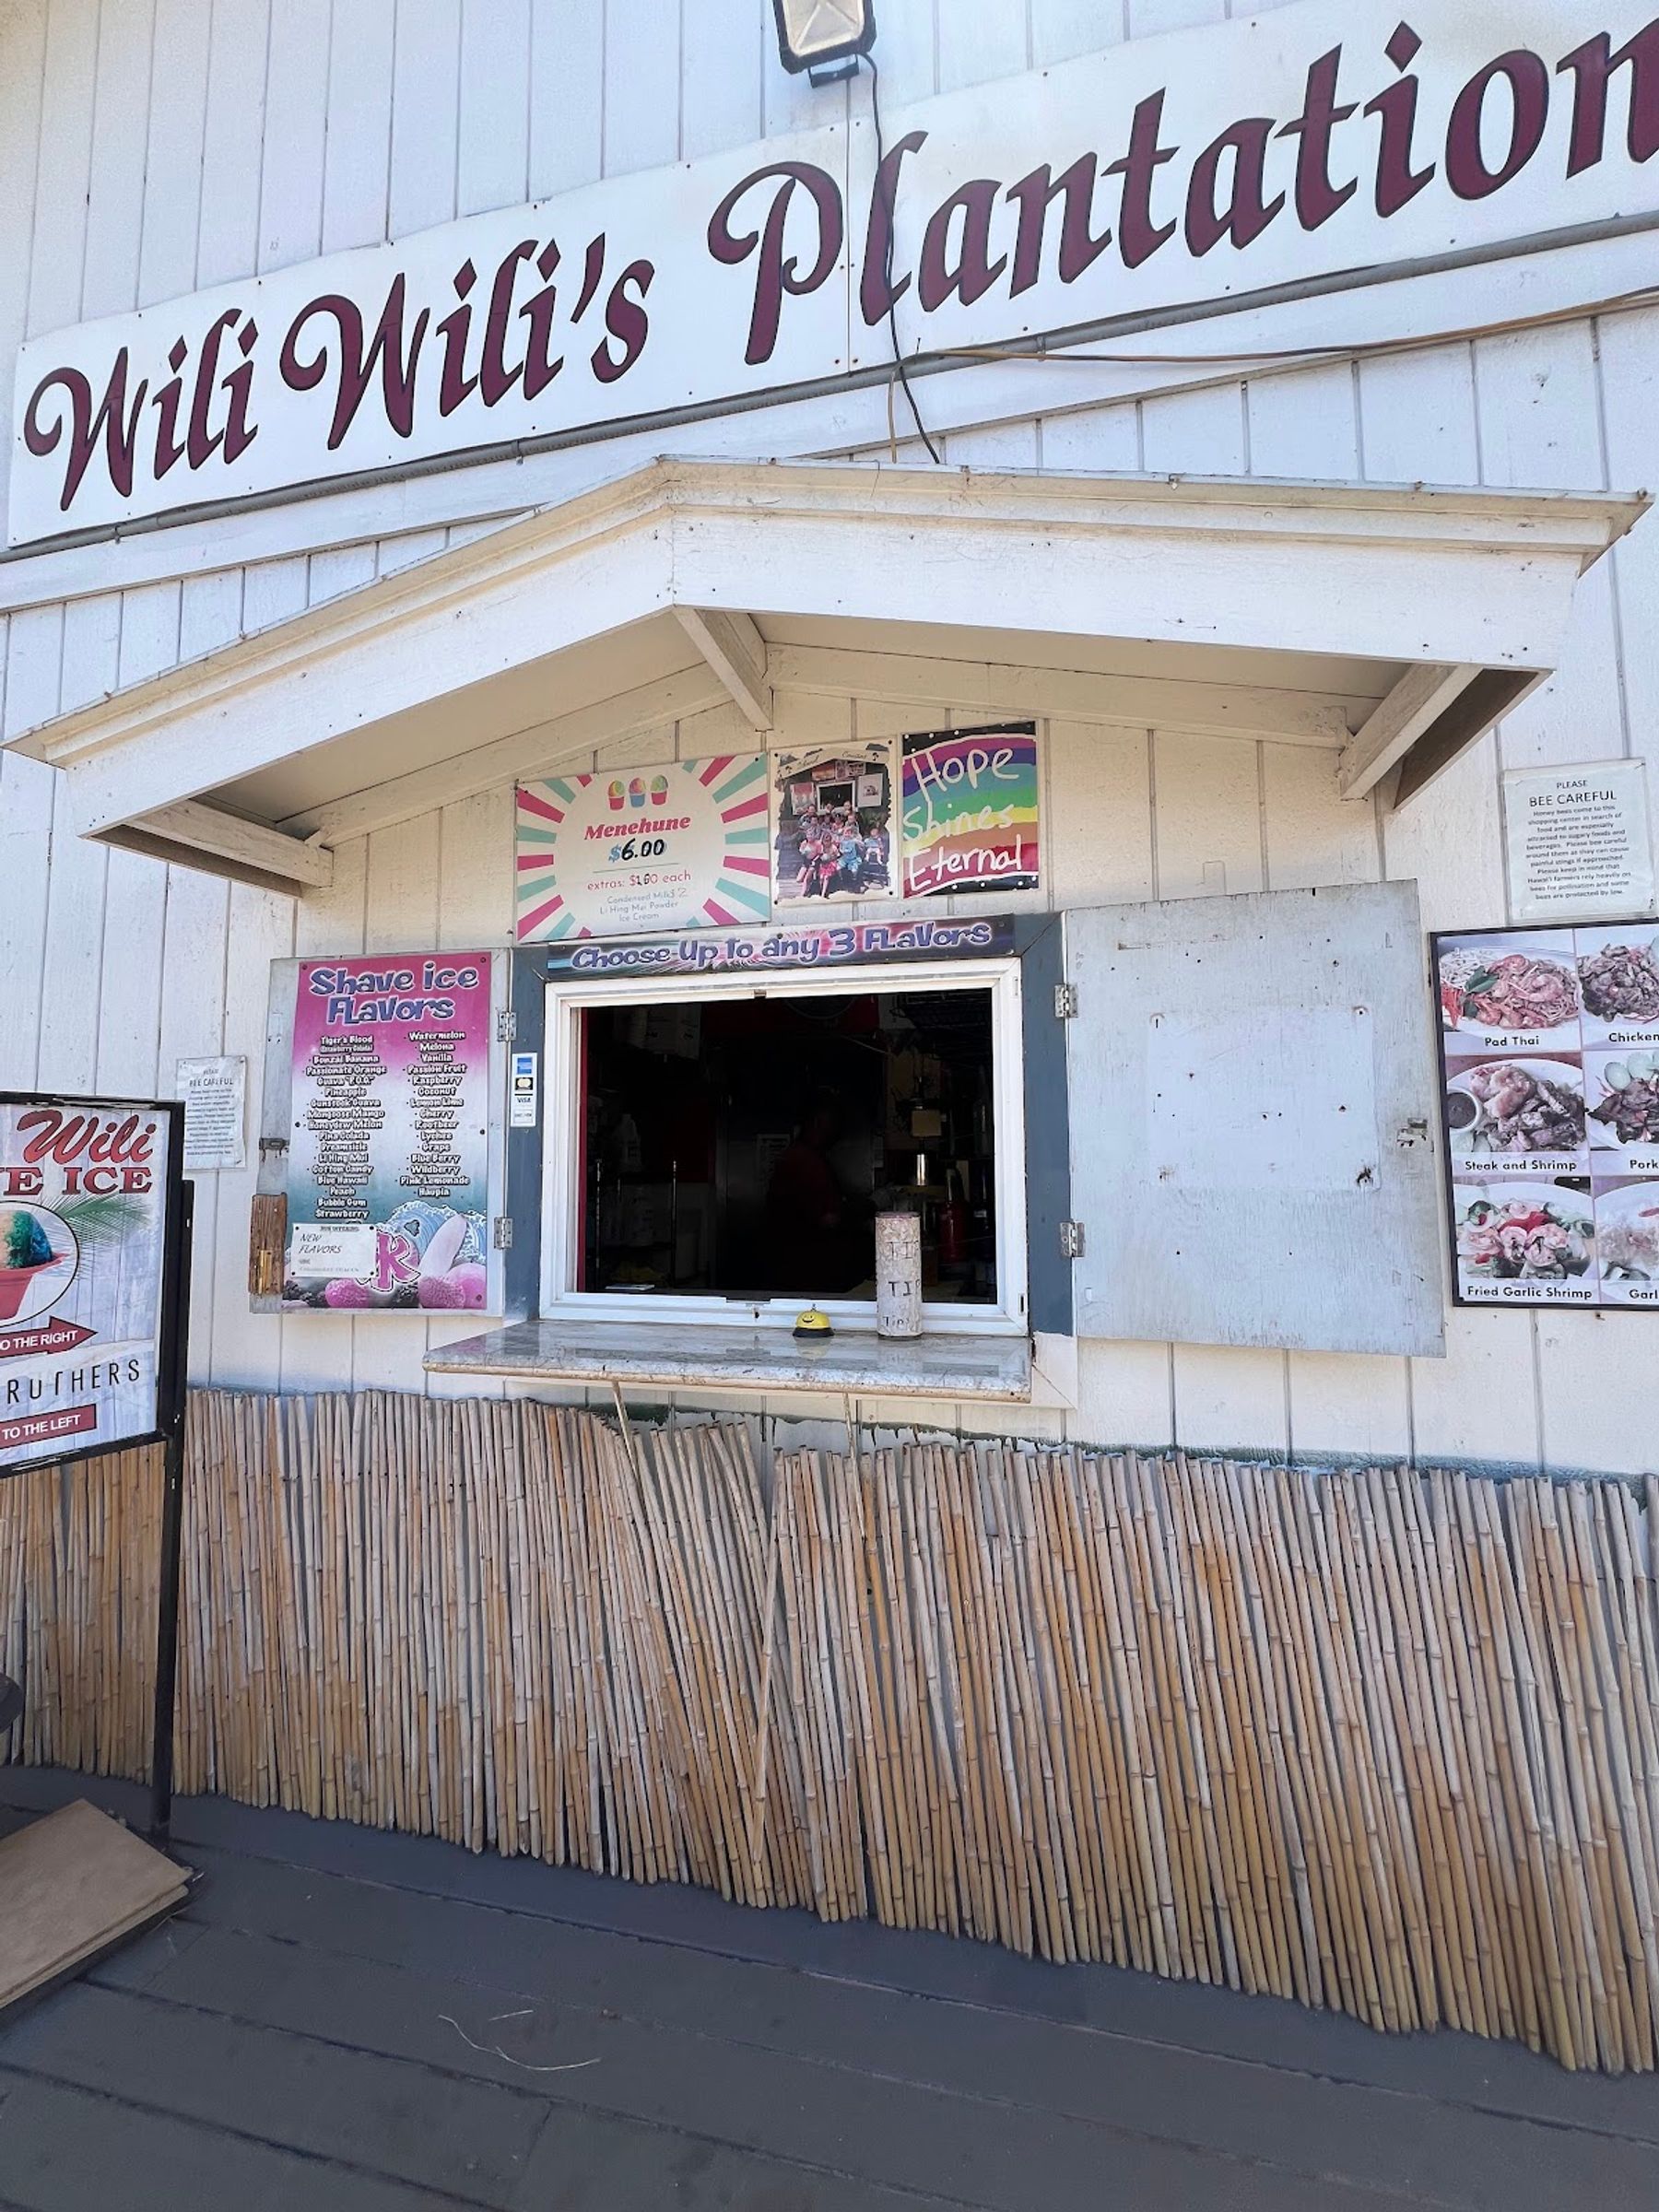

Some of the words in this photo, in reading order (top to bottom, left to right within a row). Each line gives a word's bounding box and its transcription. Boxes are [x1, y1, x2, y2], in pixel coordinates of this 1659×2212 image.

[24, 308, 259, 511] Wili
[279, 232, 655, 451] Wili's
[707, 19, 1659, 366] Plantation
[911, 747, 1020, 793] Hope
[1556, 780, 1589, 789] PLEASE
[1529, 794, 1554, 807] BEE
[1557, 790, 1617, 805] CAREFUL
[901, 800, 1015, 841] Shines
[583, 817, 691, 841] Menehune
[608, 838, 667, 863] $6.00
[908, 833, 1022, 891] Eternal
[587, 880, 625, 892] extras:
[663, 869, 691, 884] each
[607, 891, 651, 904] Condensed
[609, 904, 629, 914] Hing
[649, 900, 679, 910] Powder
[632, 912, 660, 921] Cream
[571, 946, 671, 969] Choose
[677, 935, 719, 968] Up
[762, 935, 819, 963] any
[828, 927, 856, 958] 3
[310, 968, 415, 995] Shave
[422, 960, 478, 991] ice
[349, 1034, 374, 1045] Blood
[408, 1030, 466, 1041] Watermelon
[1484, 1037, 1508, 1047] Pad
[1512, 1035, 1539, 1046] Thai
[1607, 1031, 1659, 1043] Chicken
[419, 1042, 455, 1053] Melona
[345, 1054, 380, 1064] Banana
[420, 1053, 453, 1063] Vanilla
[306, 1066, 353, 1077] Passionate
[354, 1065, 387, 1076] Orange
[406, 1065, 442, 1076] Passion
[443, 1064, 467, 1074] Fruit
[317, 1077, 345, 1086] Guava
[412, 1076, 463, 1087] Raspberry
[324, 1088, 368, 1098] Pineapple
[418, 1087, 456, 1097] Coconut
[352, 1098, 382, 1107] Guava
[410, 1098, 441, 1109] Lemon
[441, 1097, 465, 1107] Lime
[306, 1110, 351, 1121] Mongoose
[351, 1109, 385, 1119] Mango
[419, 1108, 454, 1119] Cherry
[353, 1120, 382, 1130] Melon
[17, 1109, 157, 1165] Wili
[339, 1131, 371, 1141] Colada
[420, 1131, 453, 1143] Lychee
[422, 1143, 451, 1154] Grape
[328, 1153, 348, 1164] Hing
[349, 1154, 369, 1163] Mui
[411, 1153, 431, 1163] Blue
[431, 1153, 461, 1164] Berry
[312, 1165, 344, 1174] Cotton
[345, 1165, 374, 1175] Candy
[411, 1164, 461, 1175] Wildberry
[1465, 1160, 1499, 1171] Steak
[1502, 1159, 1526, 1171] and
[1531, 1159, 1577, 1171] Shrimp
[1630, 1159, 1658, 1170] Pork
[0, 1167, 44, 1195] E
[62, 1166, 153, 1195] ICE
[317, 1176, 336, 1185] Blue
[400, 1175, 422, 1186] Pink
[423, 1175, 471, 1186] Lemonade
[329, 1186, 356, 1196] Peach
[418, 1187, 451, 1199] Haupia
[317, 1198, 346, 1207] Bubble
[347, 1198, 368, 1207] Gum
[315, 1208, 370, 1219] Strawberry
[298, 1244, 343, 1254] FLAVORS
[1467, 1286, 1499, 1297] Fried
[1502, 1286, 1542, 1297] Garlic
[1546, 1287, 1593, 1300] Shrimp
[13, 1335, 39, 1349] THE
[41, 1330, 78, 1346] RIGHT
[3, 1428, 20, 1440] TO
[22, 1420, 49, 1437] THE
[50, 1414, 81, 1430] LEFT
